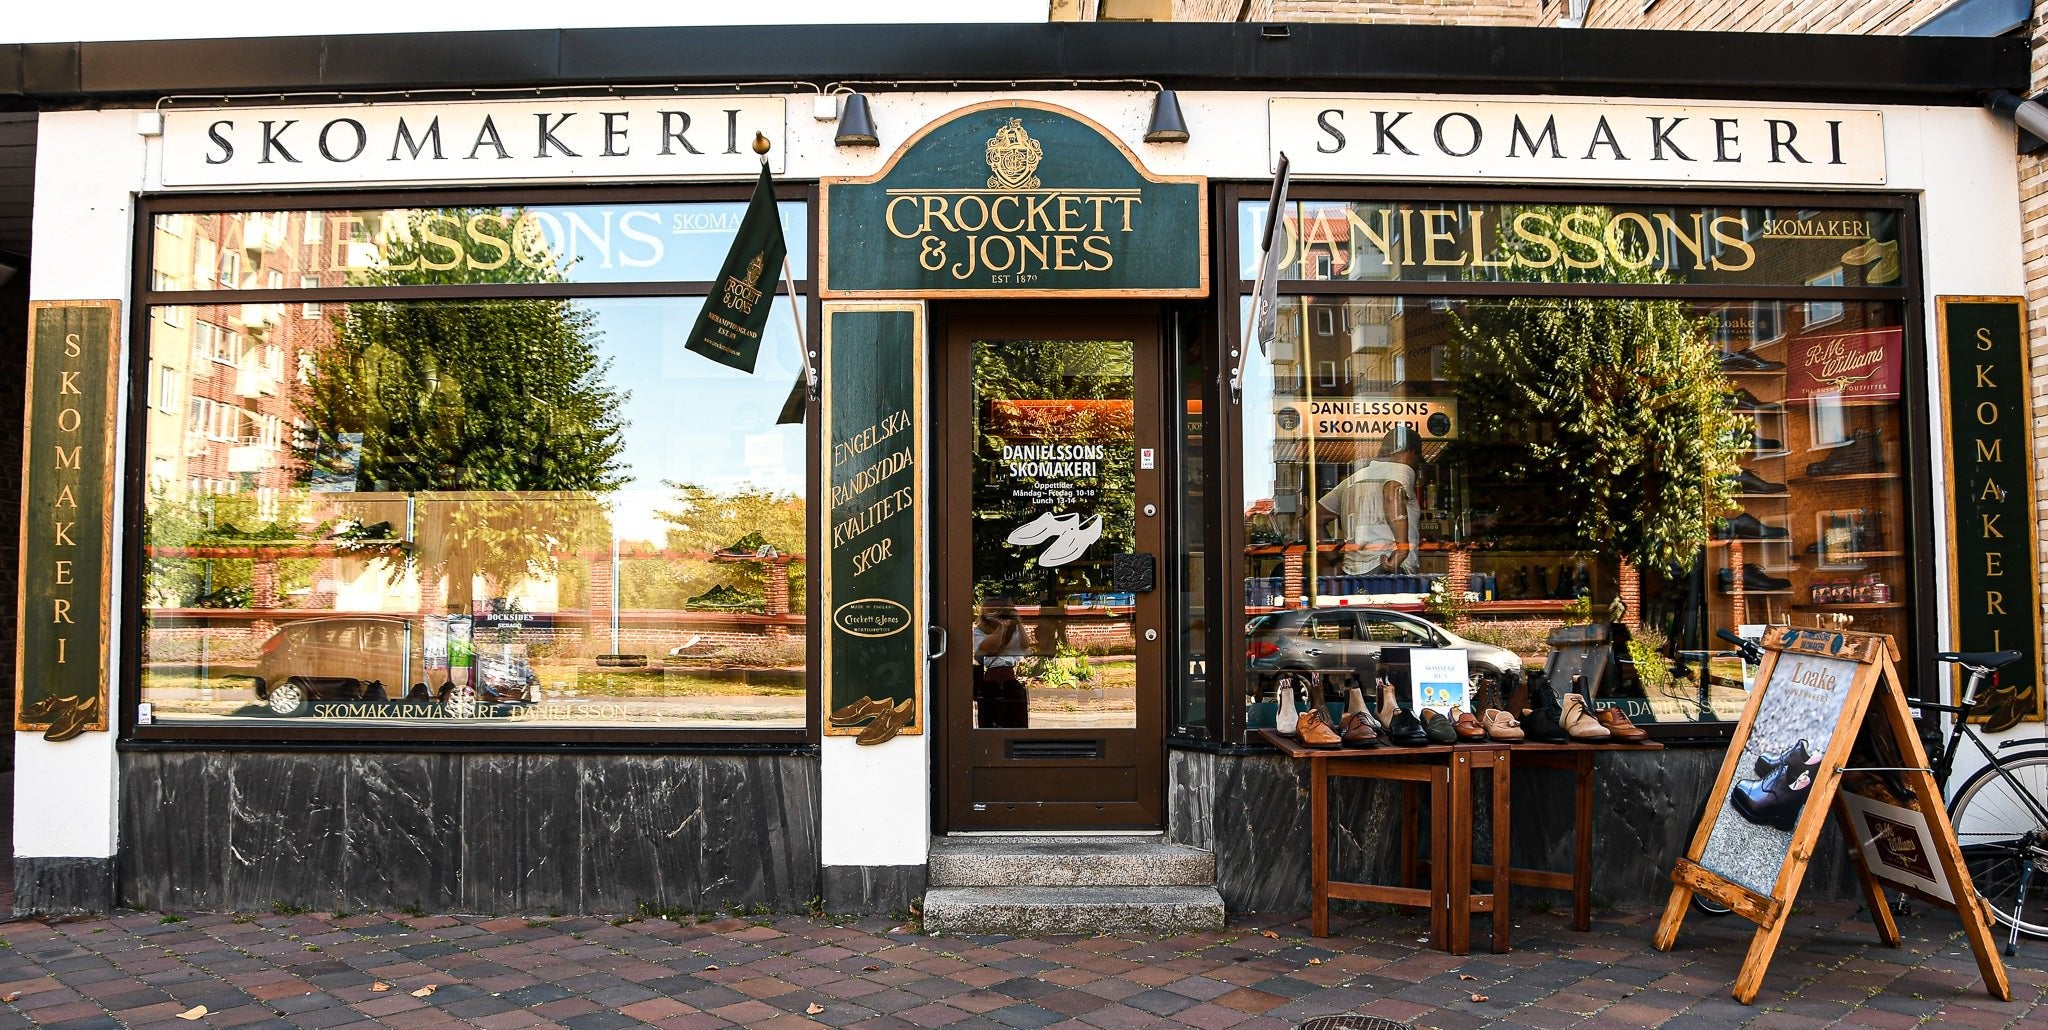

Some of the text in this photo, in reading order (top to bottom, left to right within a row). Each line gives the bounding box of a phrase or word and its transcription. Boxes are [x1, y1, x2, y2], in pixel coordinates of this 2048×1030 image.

[205, 109, 742, 165] SKOMAKERI
[1316, 109, 1847, 165] SKOMAKERI
[672, 211, 790, 234] SKOMAI
[885, 192, 1142, 239] CROCKETT
[1762, 219, 1871, 239] SKOMAKERI
[919, 235, 1114, 280] & JONES
[1246, 207, 1756, 275] DANIELSSONS
[1822, 346, 1884, 377] Williams
[1311, 402, 1428, 416] DANIELSSONS
[834, 409, 912, 467] ENGELSKA
[1003, 444, 1104, 460] DANIELSSONS
[831, 446, 914, 510] RANDSYDDA
[1009, 462, 1097, 477] SKOMAKERI
[1975, 327, 2007, 652] SKOMAKERI
[52, 332, 82, 665] SKOMAKERI
[1012, 490, 1042, 498] Måndag
[833, 486, 914, 550] KVALITETS
[852, 537, 894, 577] SKOR
[1791, 662, 1836, 691] Loake
